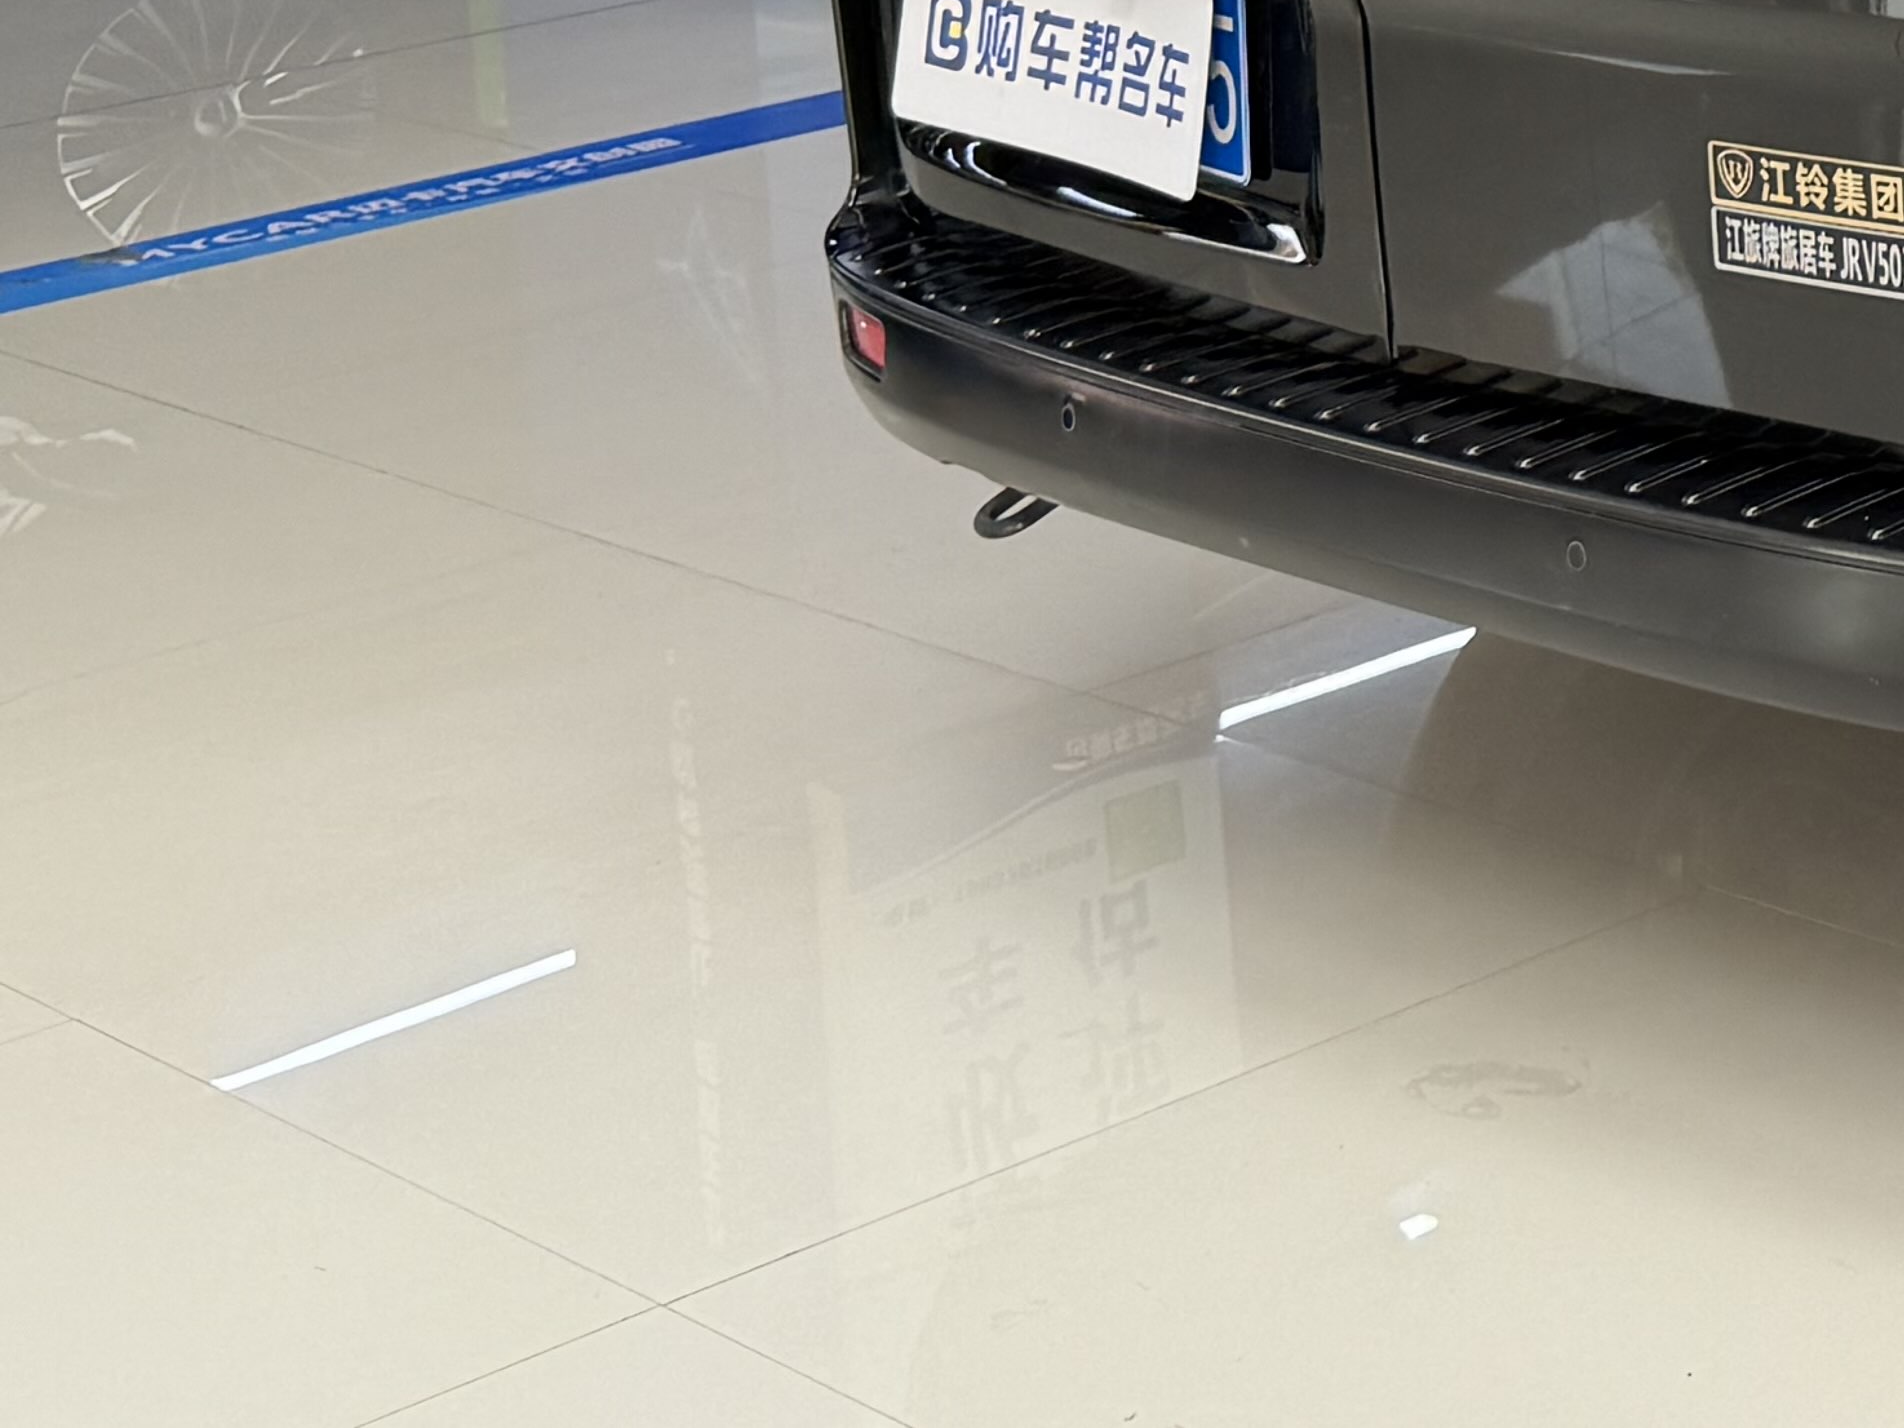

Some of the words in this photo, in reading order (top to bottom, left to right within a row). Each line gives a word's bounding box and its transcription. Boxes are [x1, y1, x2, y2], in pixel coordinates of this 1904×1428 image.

[1724, 216, 1837, 280] 江旅牌旅居车
